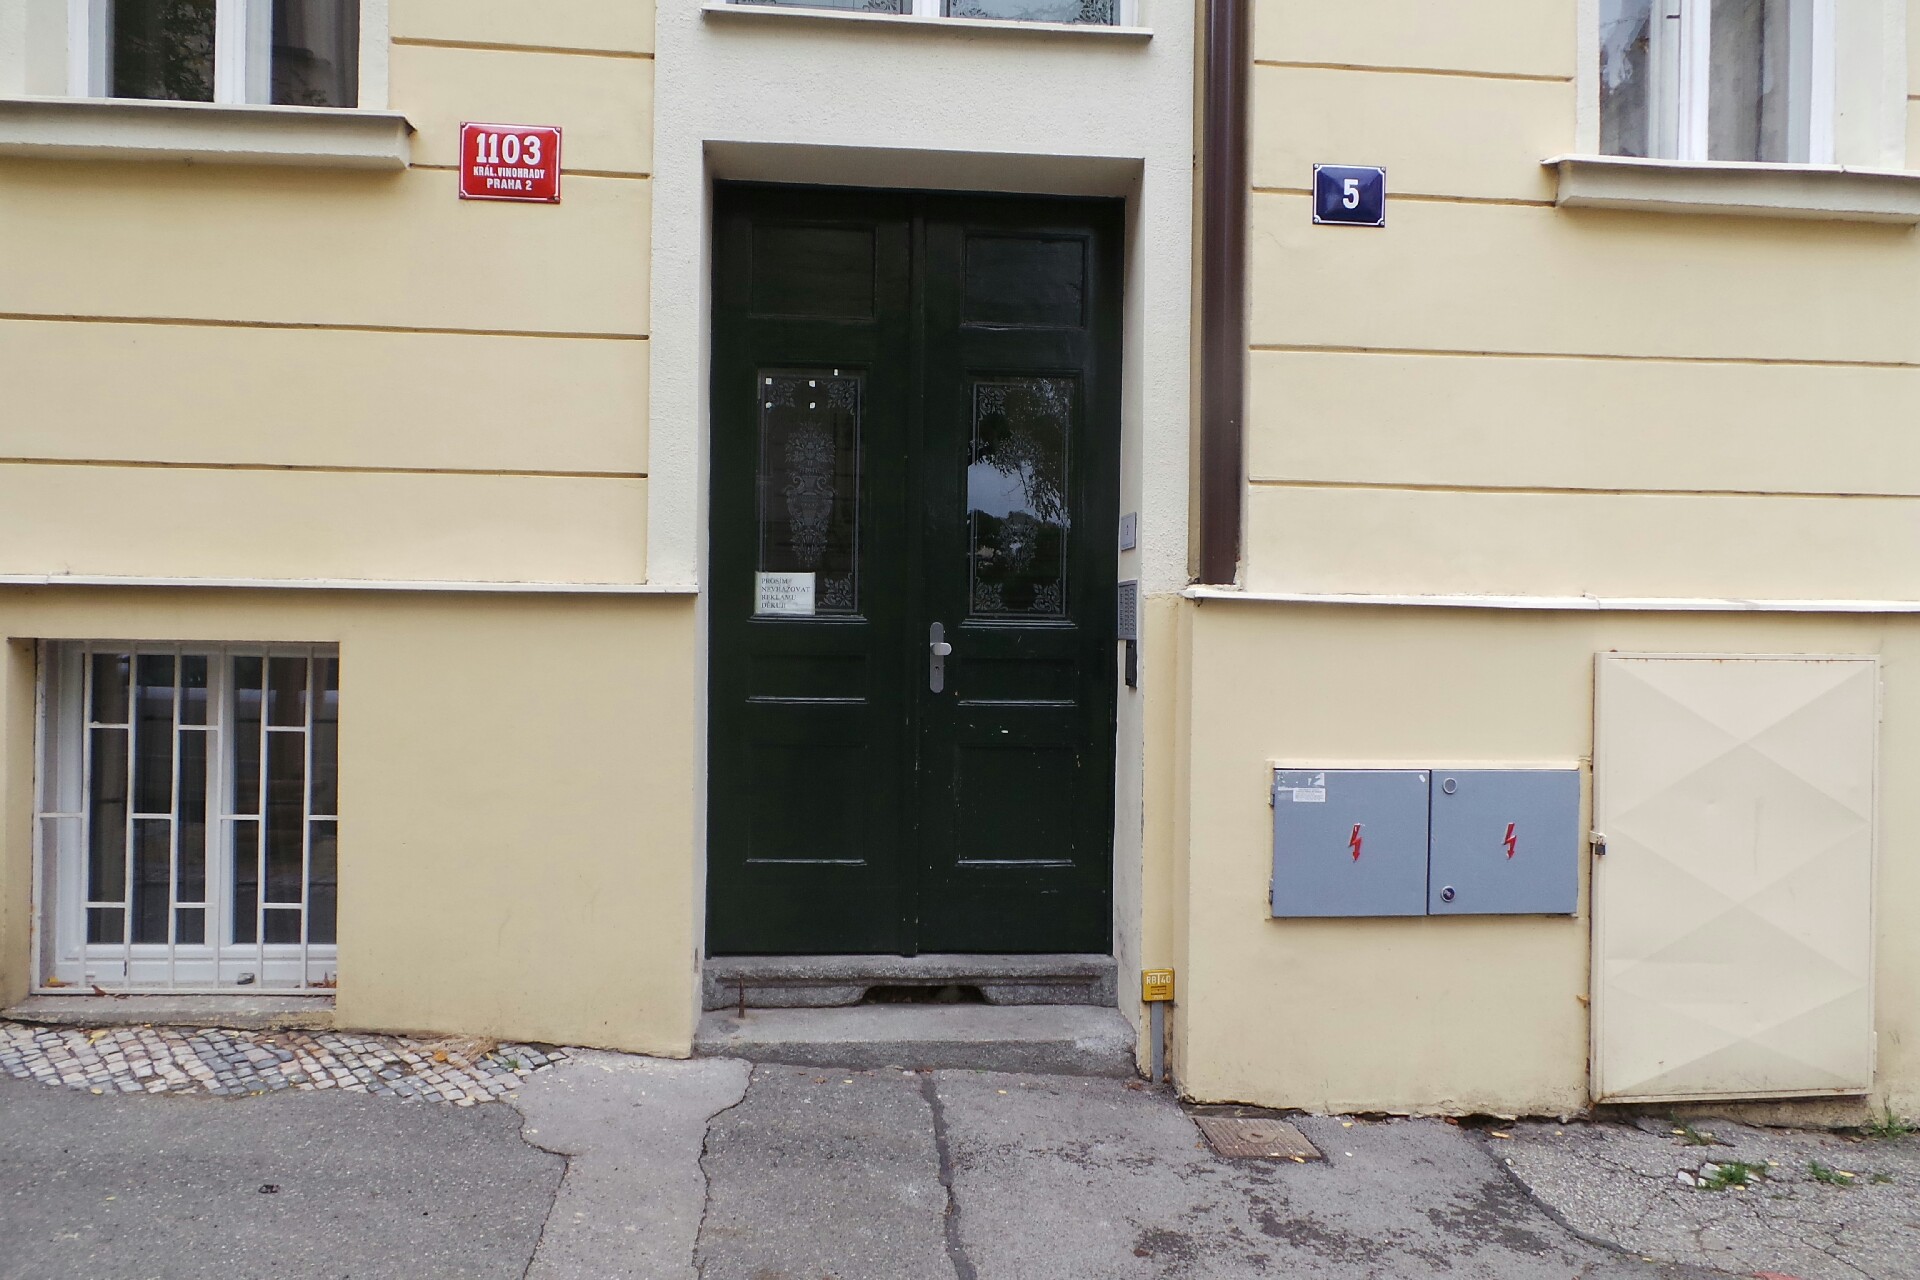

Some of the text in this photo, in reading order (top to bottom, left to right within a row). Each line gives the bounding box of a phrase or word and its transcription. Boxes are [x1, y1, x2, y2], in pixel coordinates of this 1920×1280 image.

[476, 133, 541, 165] 1103
[486, 178, 533, 191] PRAHA 2
[1342, 178, 1360, 209] 5
